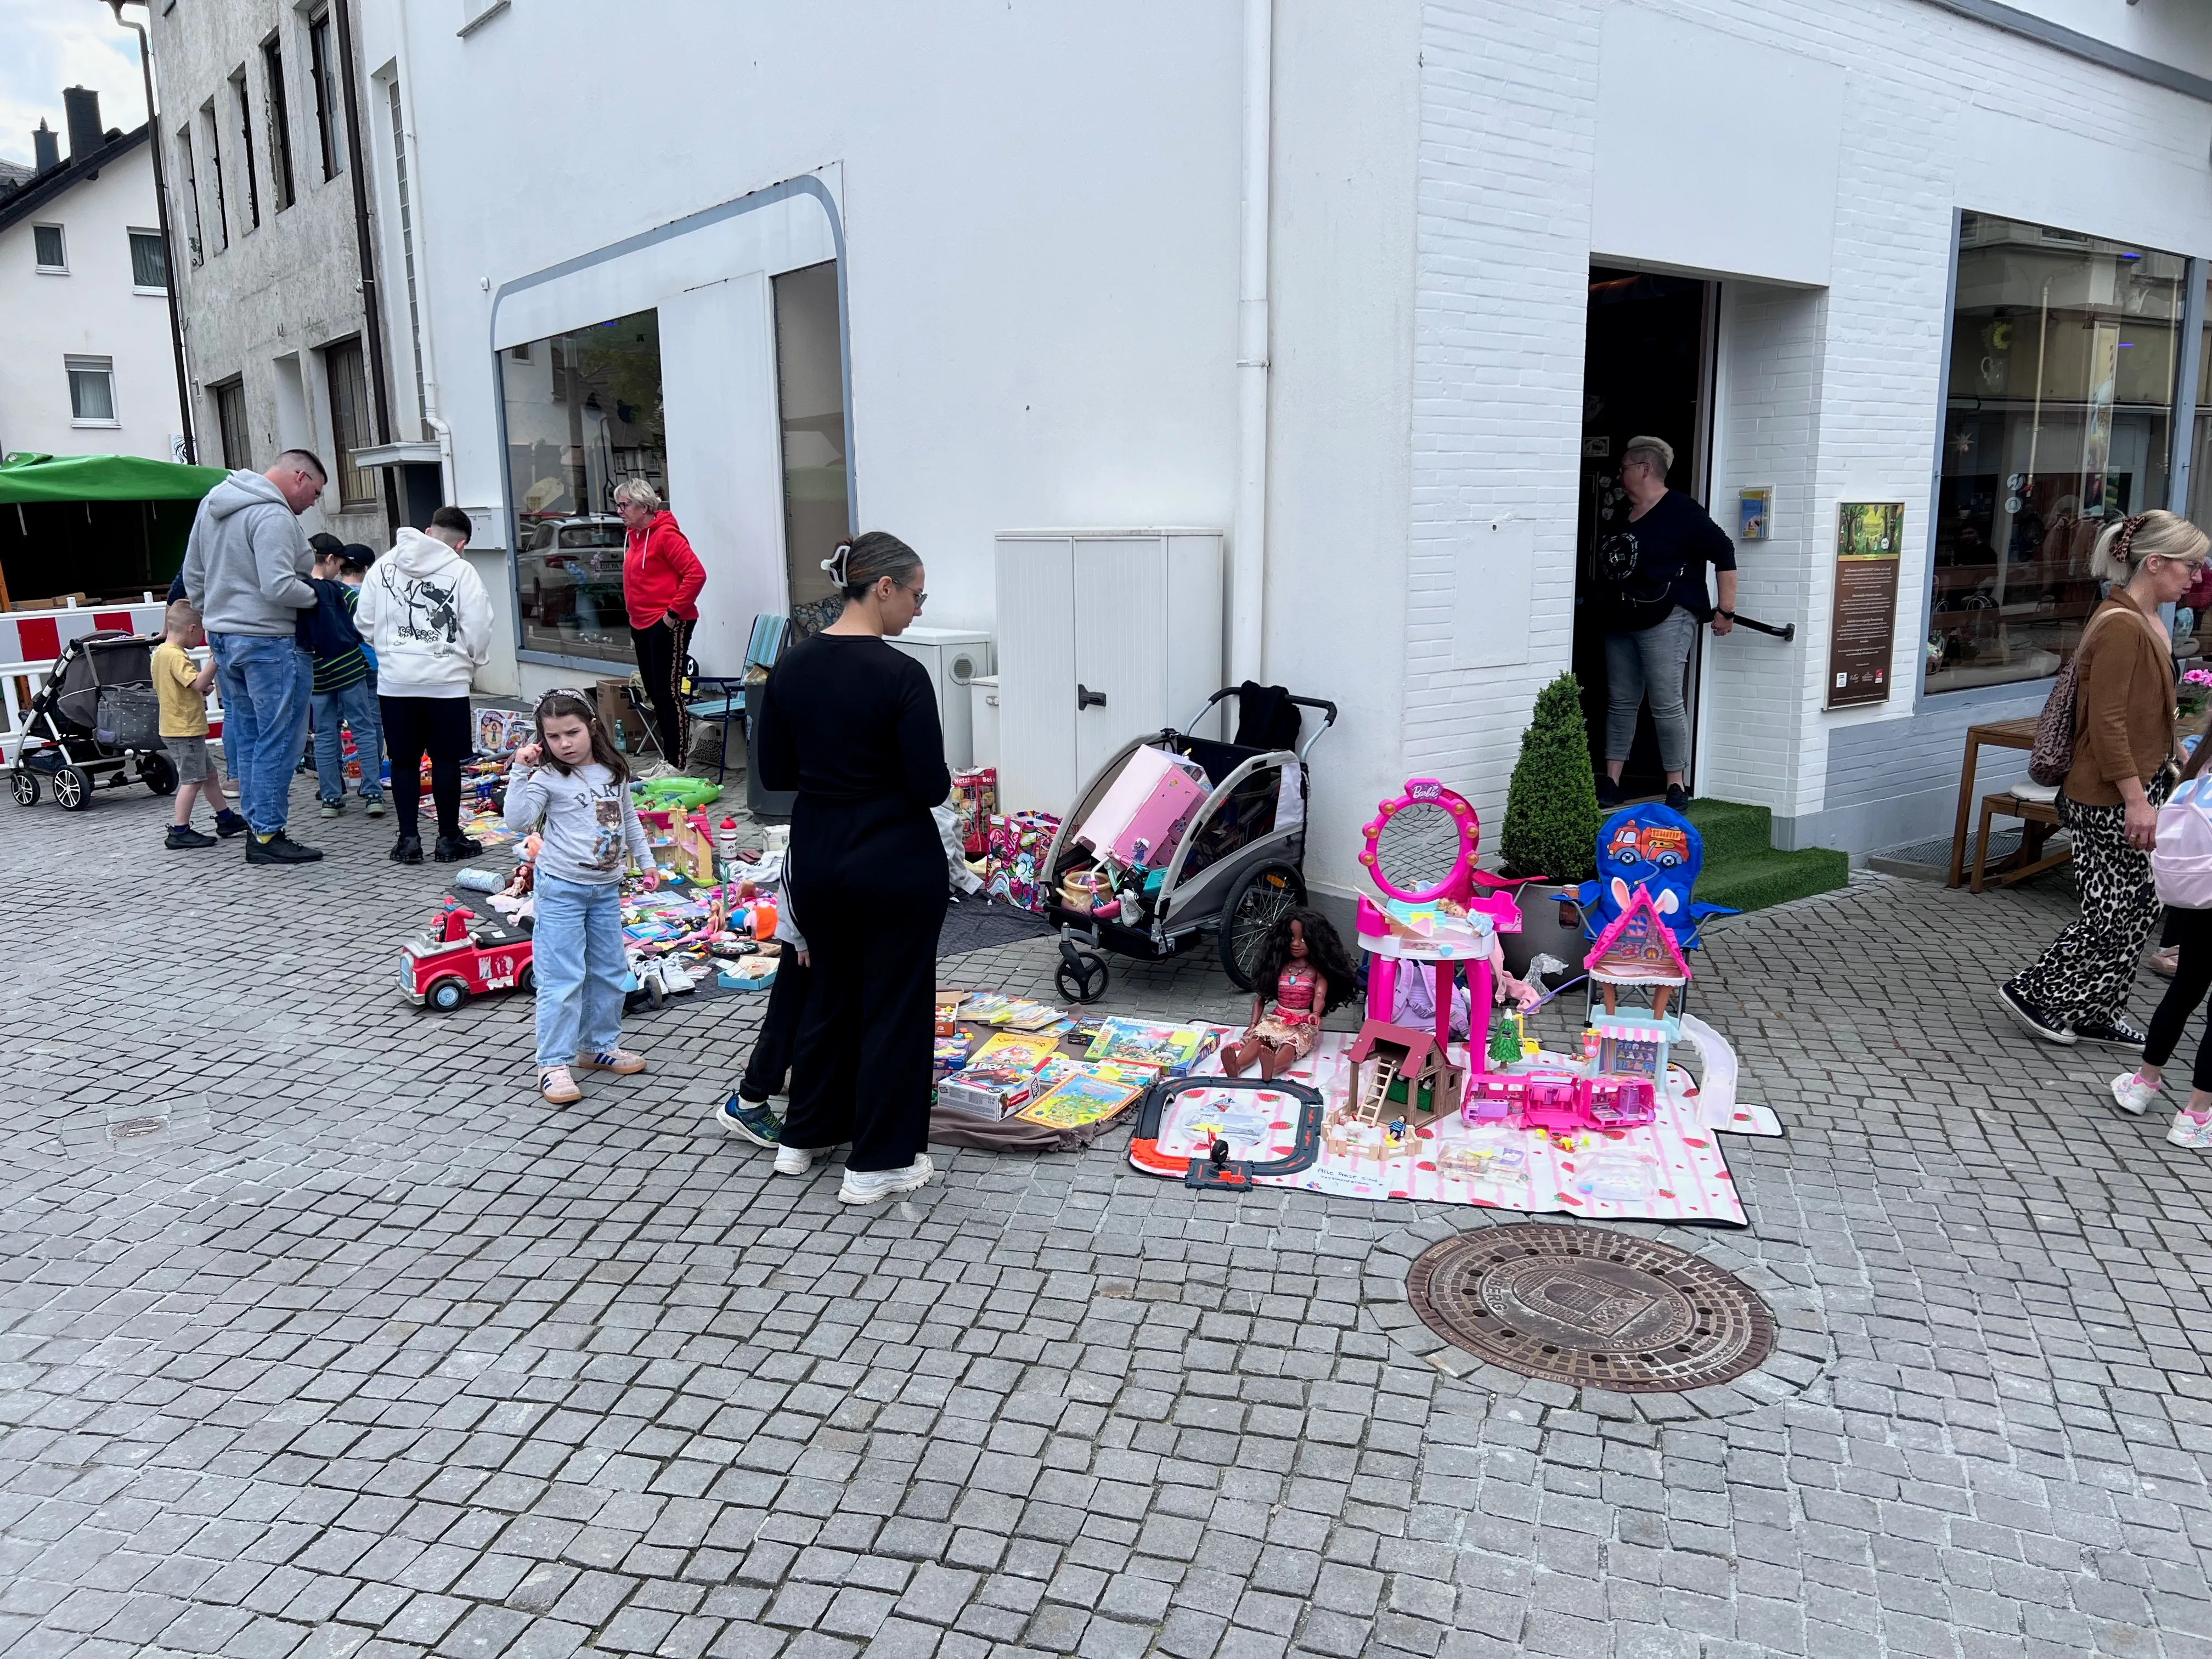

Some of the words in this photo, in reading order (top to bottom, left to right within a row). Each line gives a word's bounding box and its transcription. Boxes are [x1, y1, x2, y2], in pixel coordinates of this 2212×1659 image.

[574, 784, 624, 808] PARI
[1413, 786, 1438, 799] Barbie
[1485, 1257, 1576, 1311] PLETTENBERG
